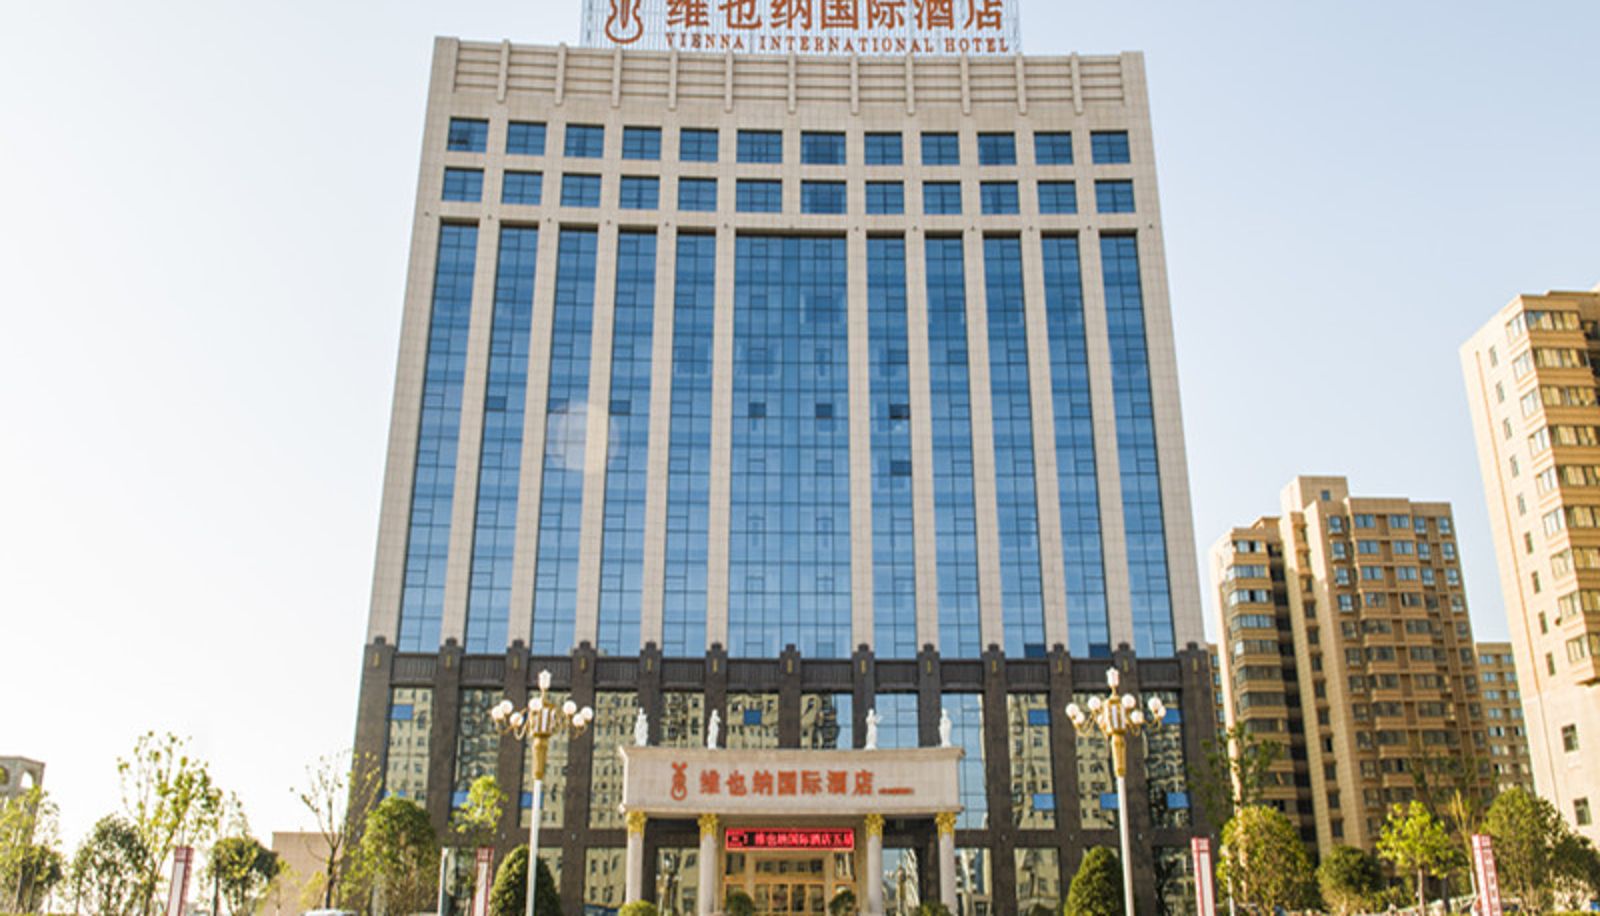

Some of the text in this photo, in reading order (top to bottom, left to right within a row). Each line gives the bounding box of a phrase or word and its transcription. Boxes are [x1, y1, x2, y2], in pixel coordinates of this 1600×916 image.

[666, 0, 1003, 30] 维也纳国际酒店
[665, 32, 1008, 53] VIENNA INTERNATIONAL HOTEL
[700, 769, 874, 796] 维也纳国际酒店
